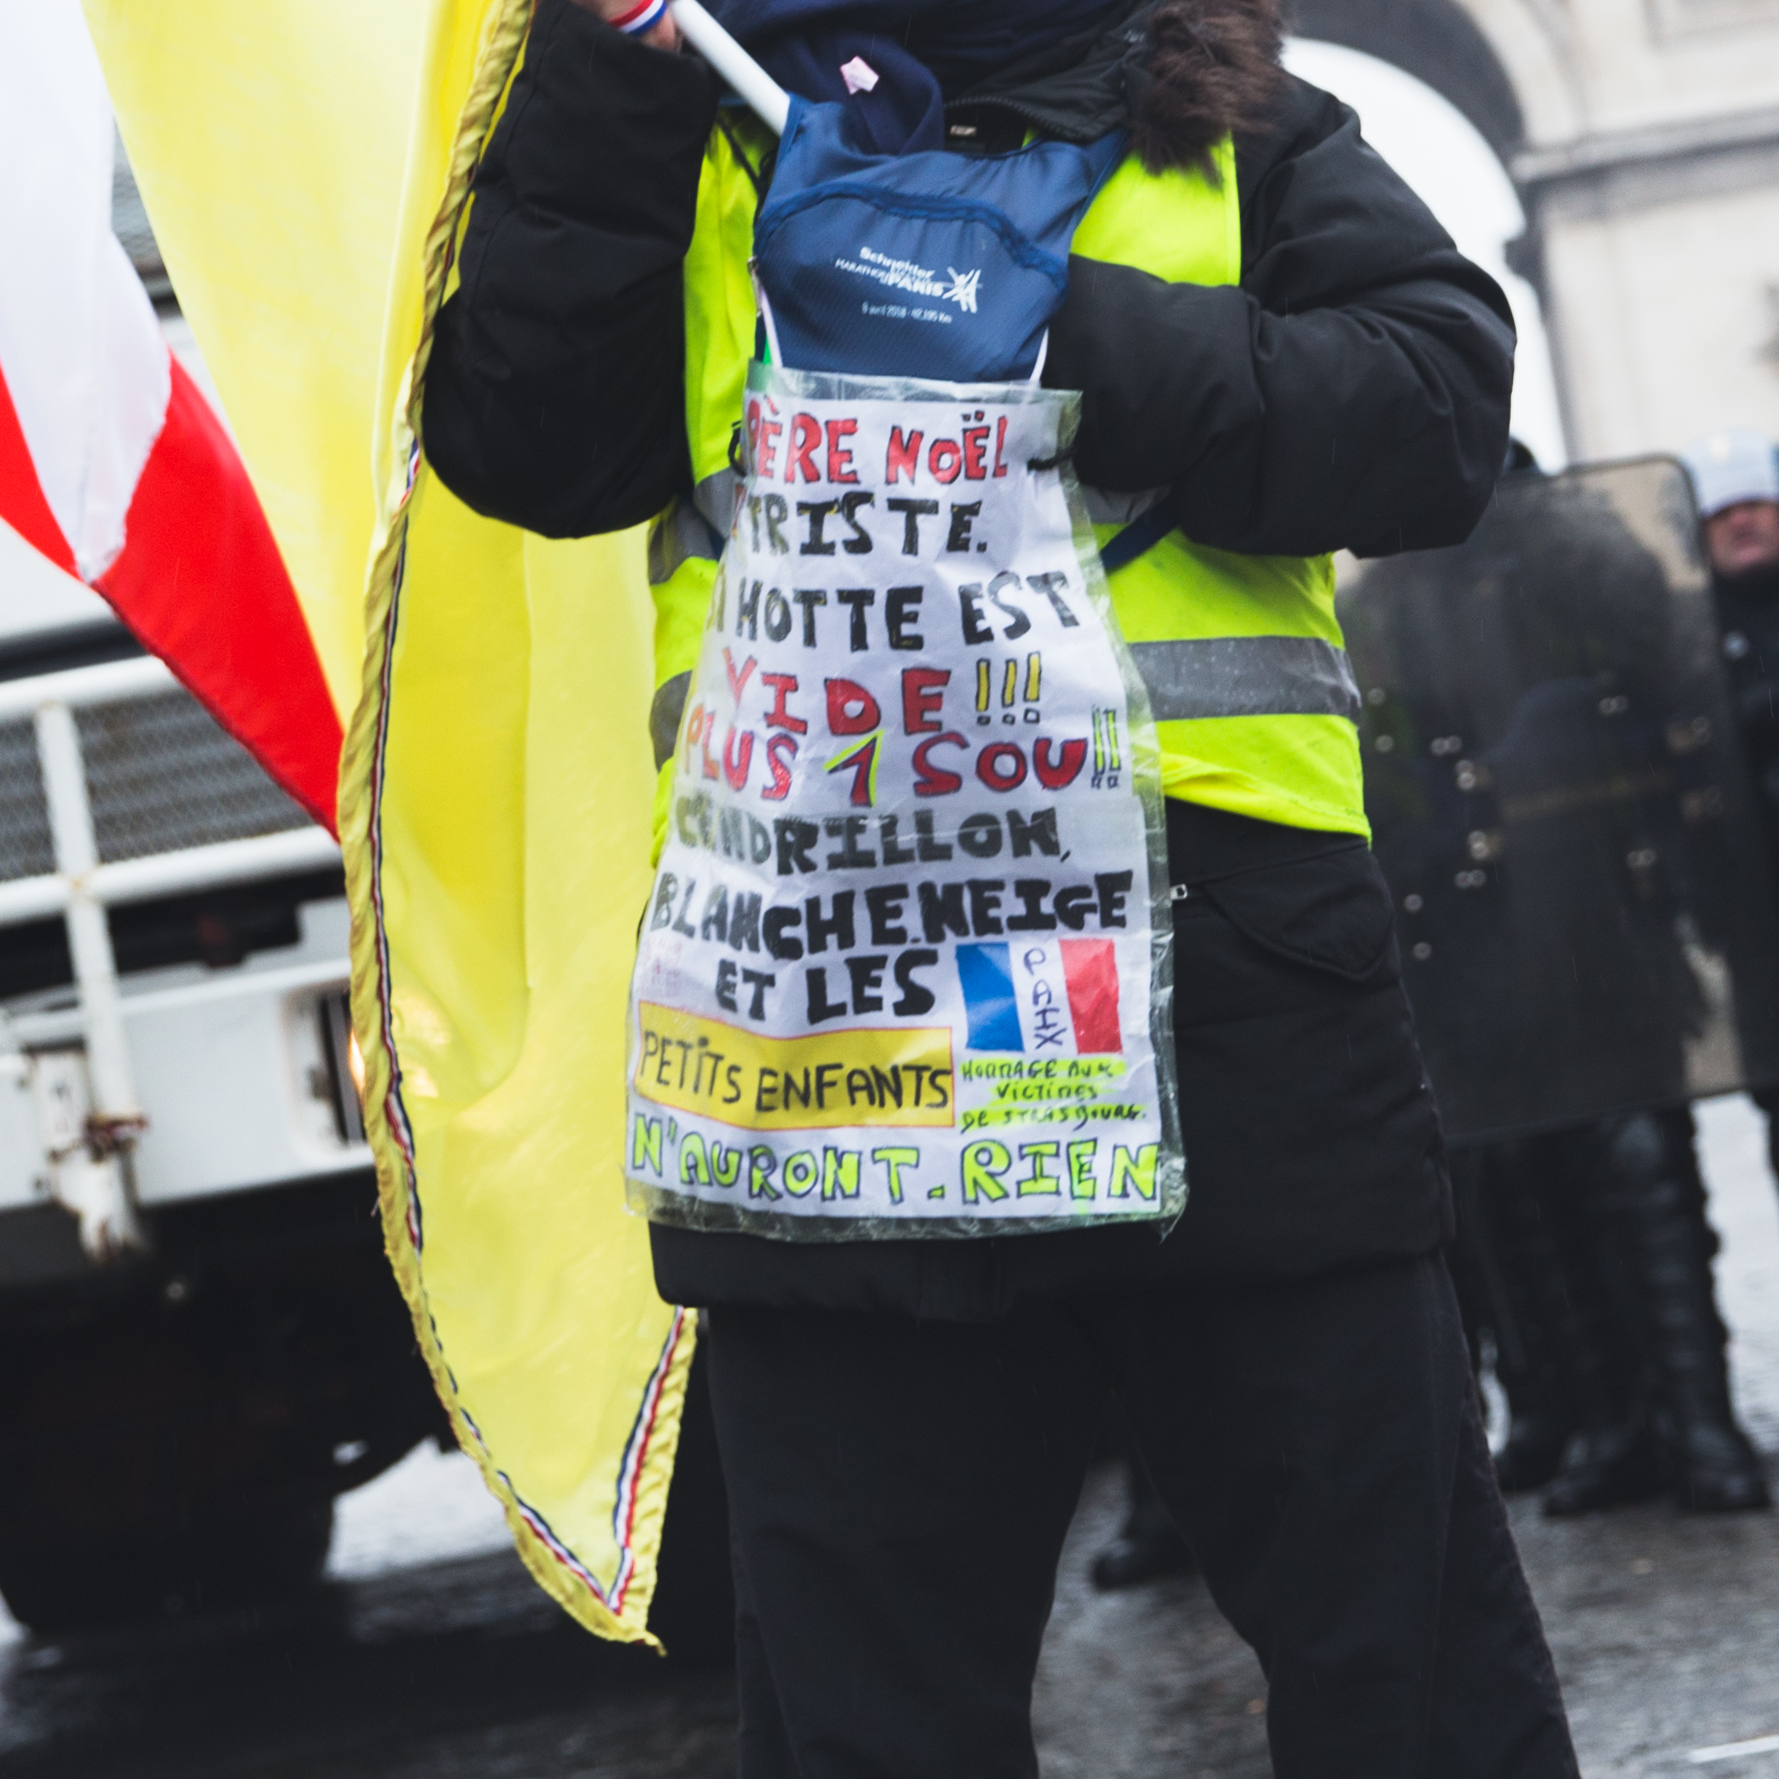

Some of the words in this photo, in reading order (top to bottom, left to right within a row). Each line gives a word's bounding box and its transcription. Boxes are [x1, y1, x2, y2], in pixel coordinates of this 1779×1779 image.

[859, 245, 936, 279] Schneider
[888, 271, 944, 298] PARIS
[745, 394, 861, 484] PÈRE
[885, 409, 1009, 486] NOËL
[735, 578, 925, 653] HOTTE
[958, 570, 1081, 646] EST
[684, 702, 799, 801] PLUS
[823, 728, 885, 808] 1
[715, 958, 776, 1021] ET
[806, 949, 938, 1025] LES
[1023, 947, 1067, 1050] PAIX
[756, 1061, 951, 1113] ENFANTS
[961, 1138, 1160, 1205] RIEN
